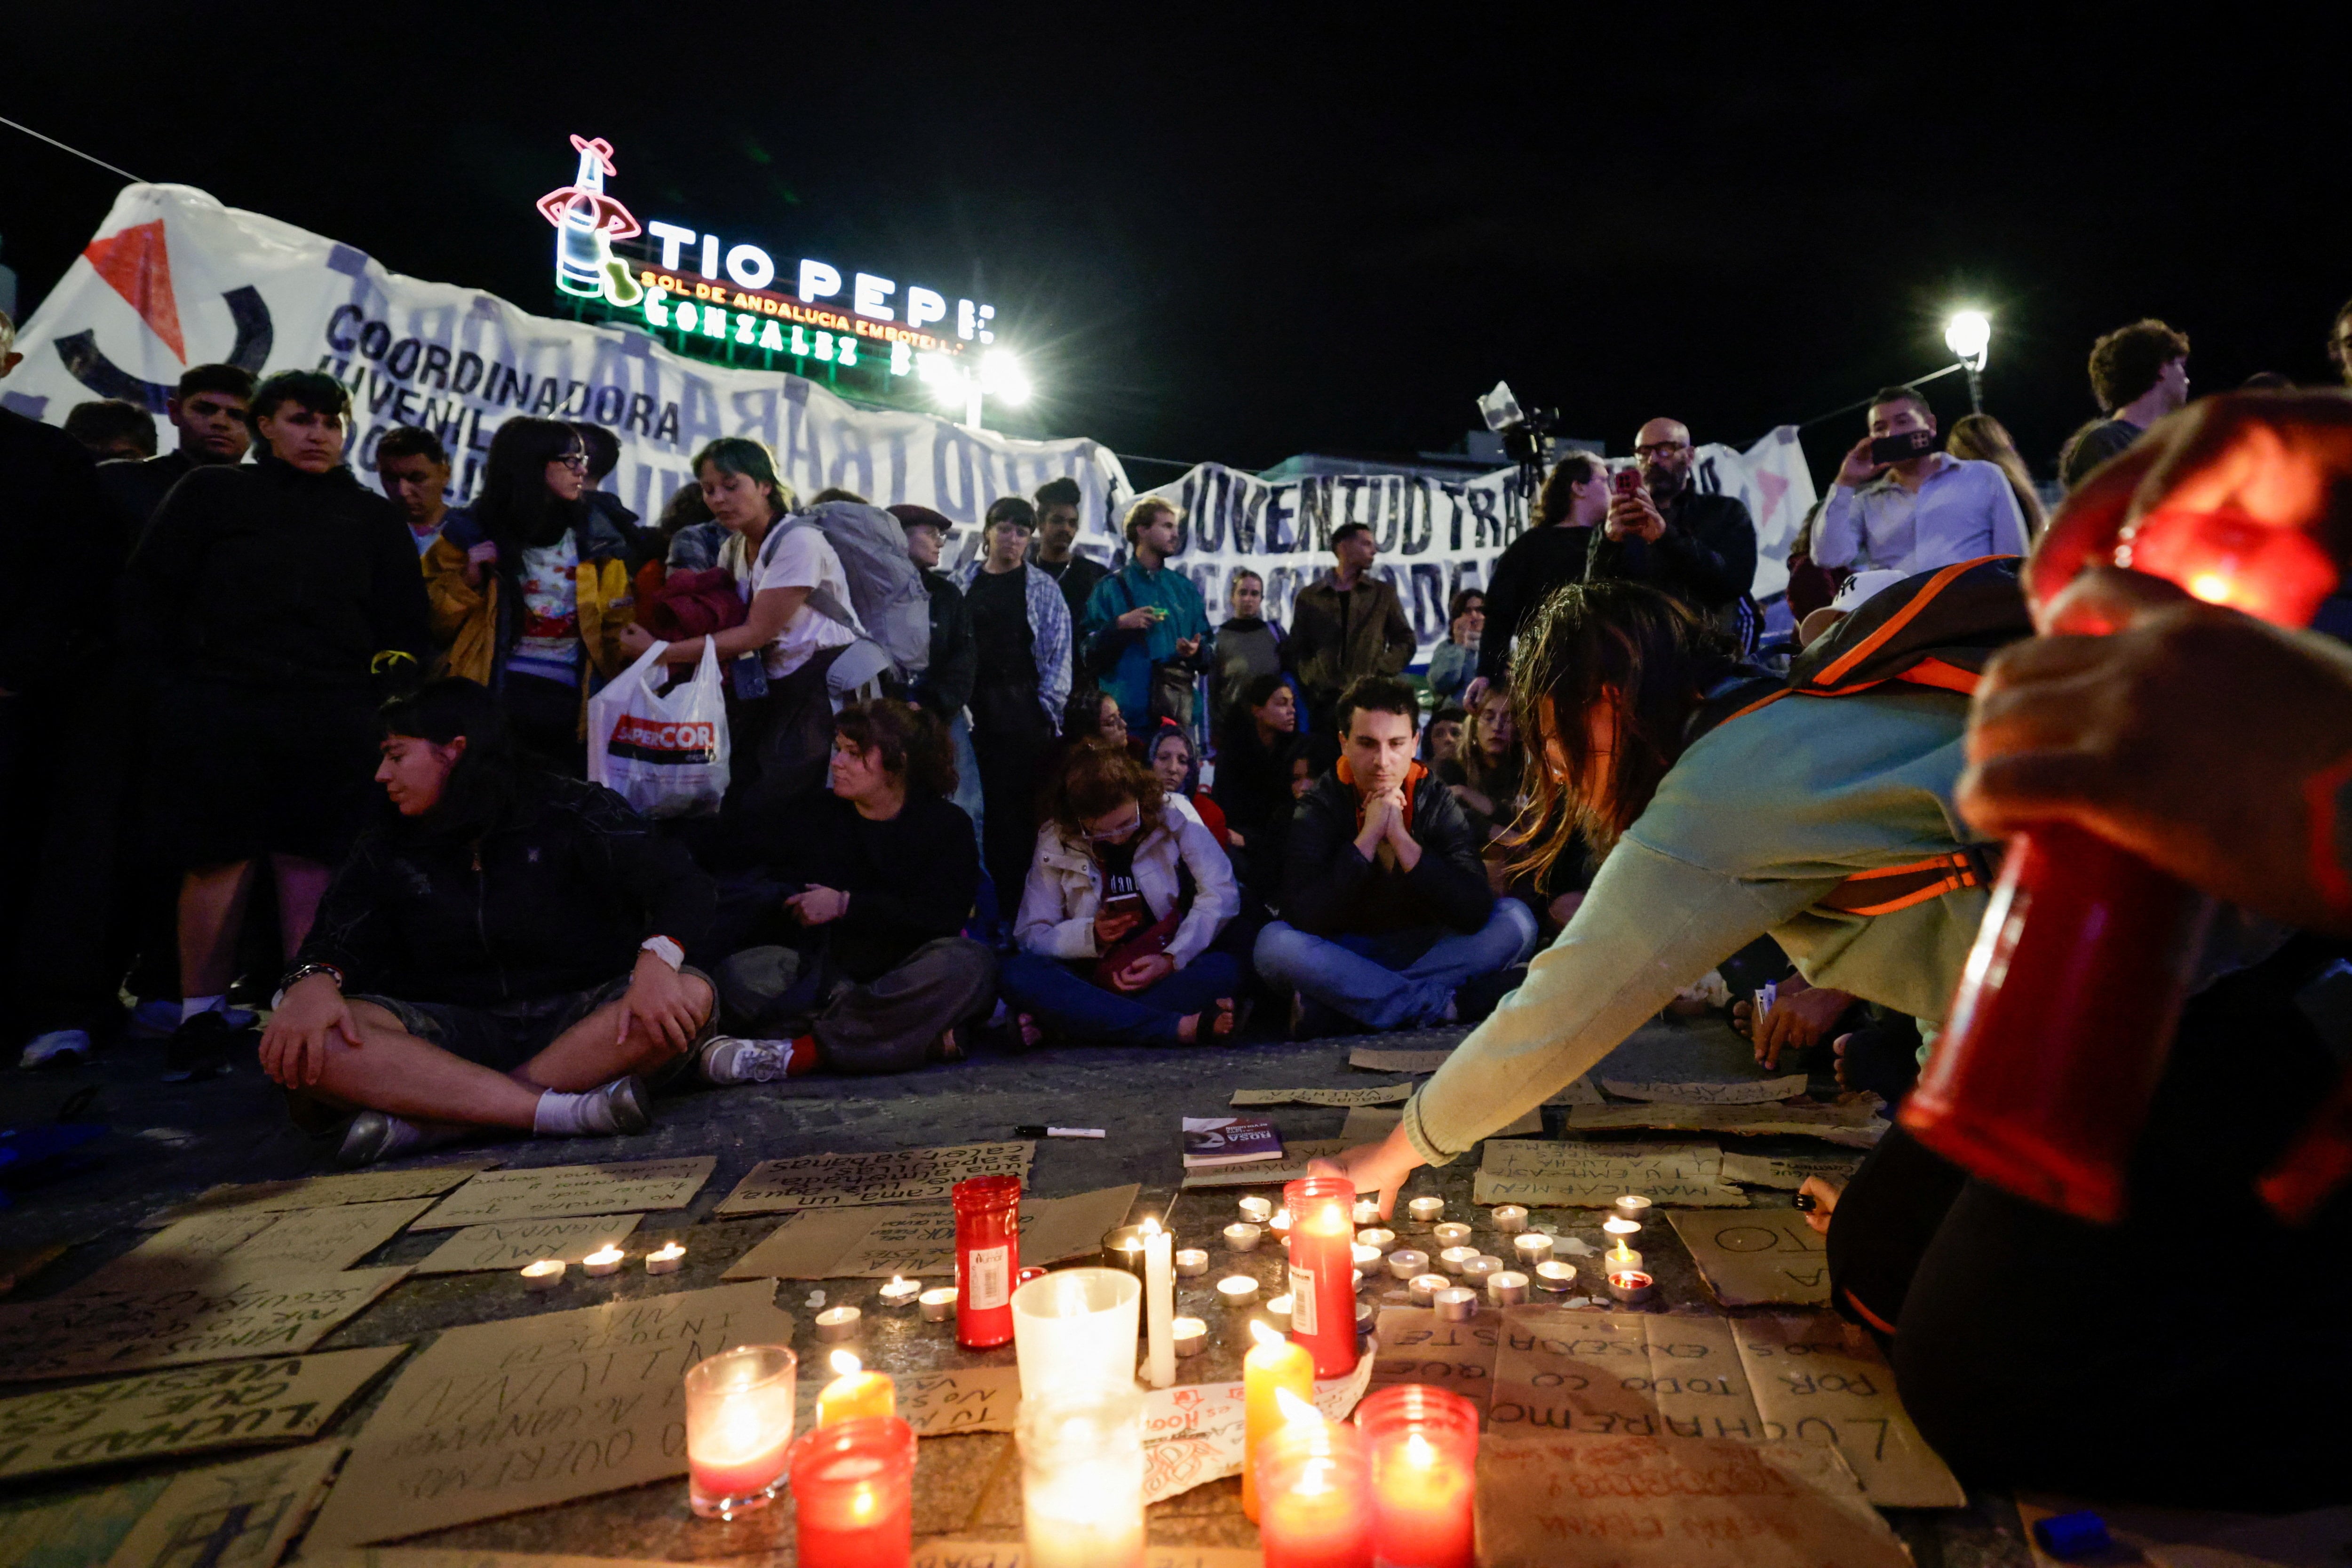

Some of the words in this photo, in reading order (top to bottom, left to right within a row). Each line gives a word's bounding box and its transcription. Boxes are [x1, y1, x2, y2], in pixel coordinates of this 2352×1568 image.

[649, 221, 775, 289] TIO
[799, 258, 995, 344] PEPE
[641, 271, 691, 296] SOL
[696, 283, 726, 304] DE
[733, 293, 850, 331] ANDALUCIA
[644, 286, 858, 366] GONZALEZ
[327, 305, 679, 446] COORDINADORA
[1227, 1130, 1271, 1141] ROSA
[966, 1162, 1021, 1173] una
[771, 1169, 951, 1186] almohada,
[548, 1191, 590, 1199] sido
[740, 1185, 822, 1200] agua,
[799, 1196, 840, 1205] un
[854, 1187, 944, 1201] cama,
[1620, 1377, 1737, 1396] TODO
[1779, 1373, 1878, 1396] POR
[943, 1389, 996, 1405] NO
[950, 1407, 996, 1425] TU
